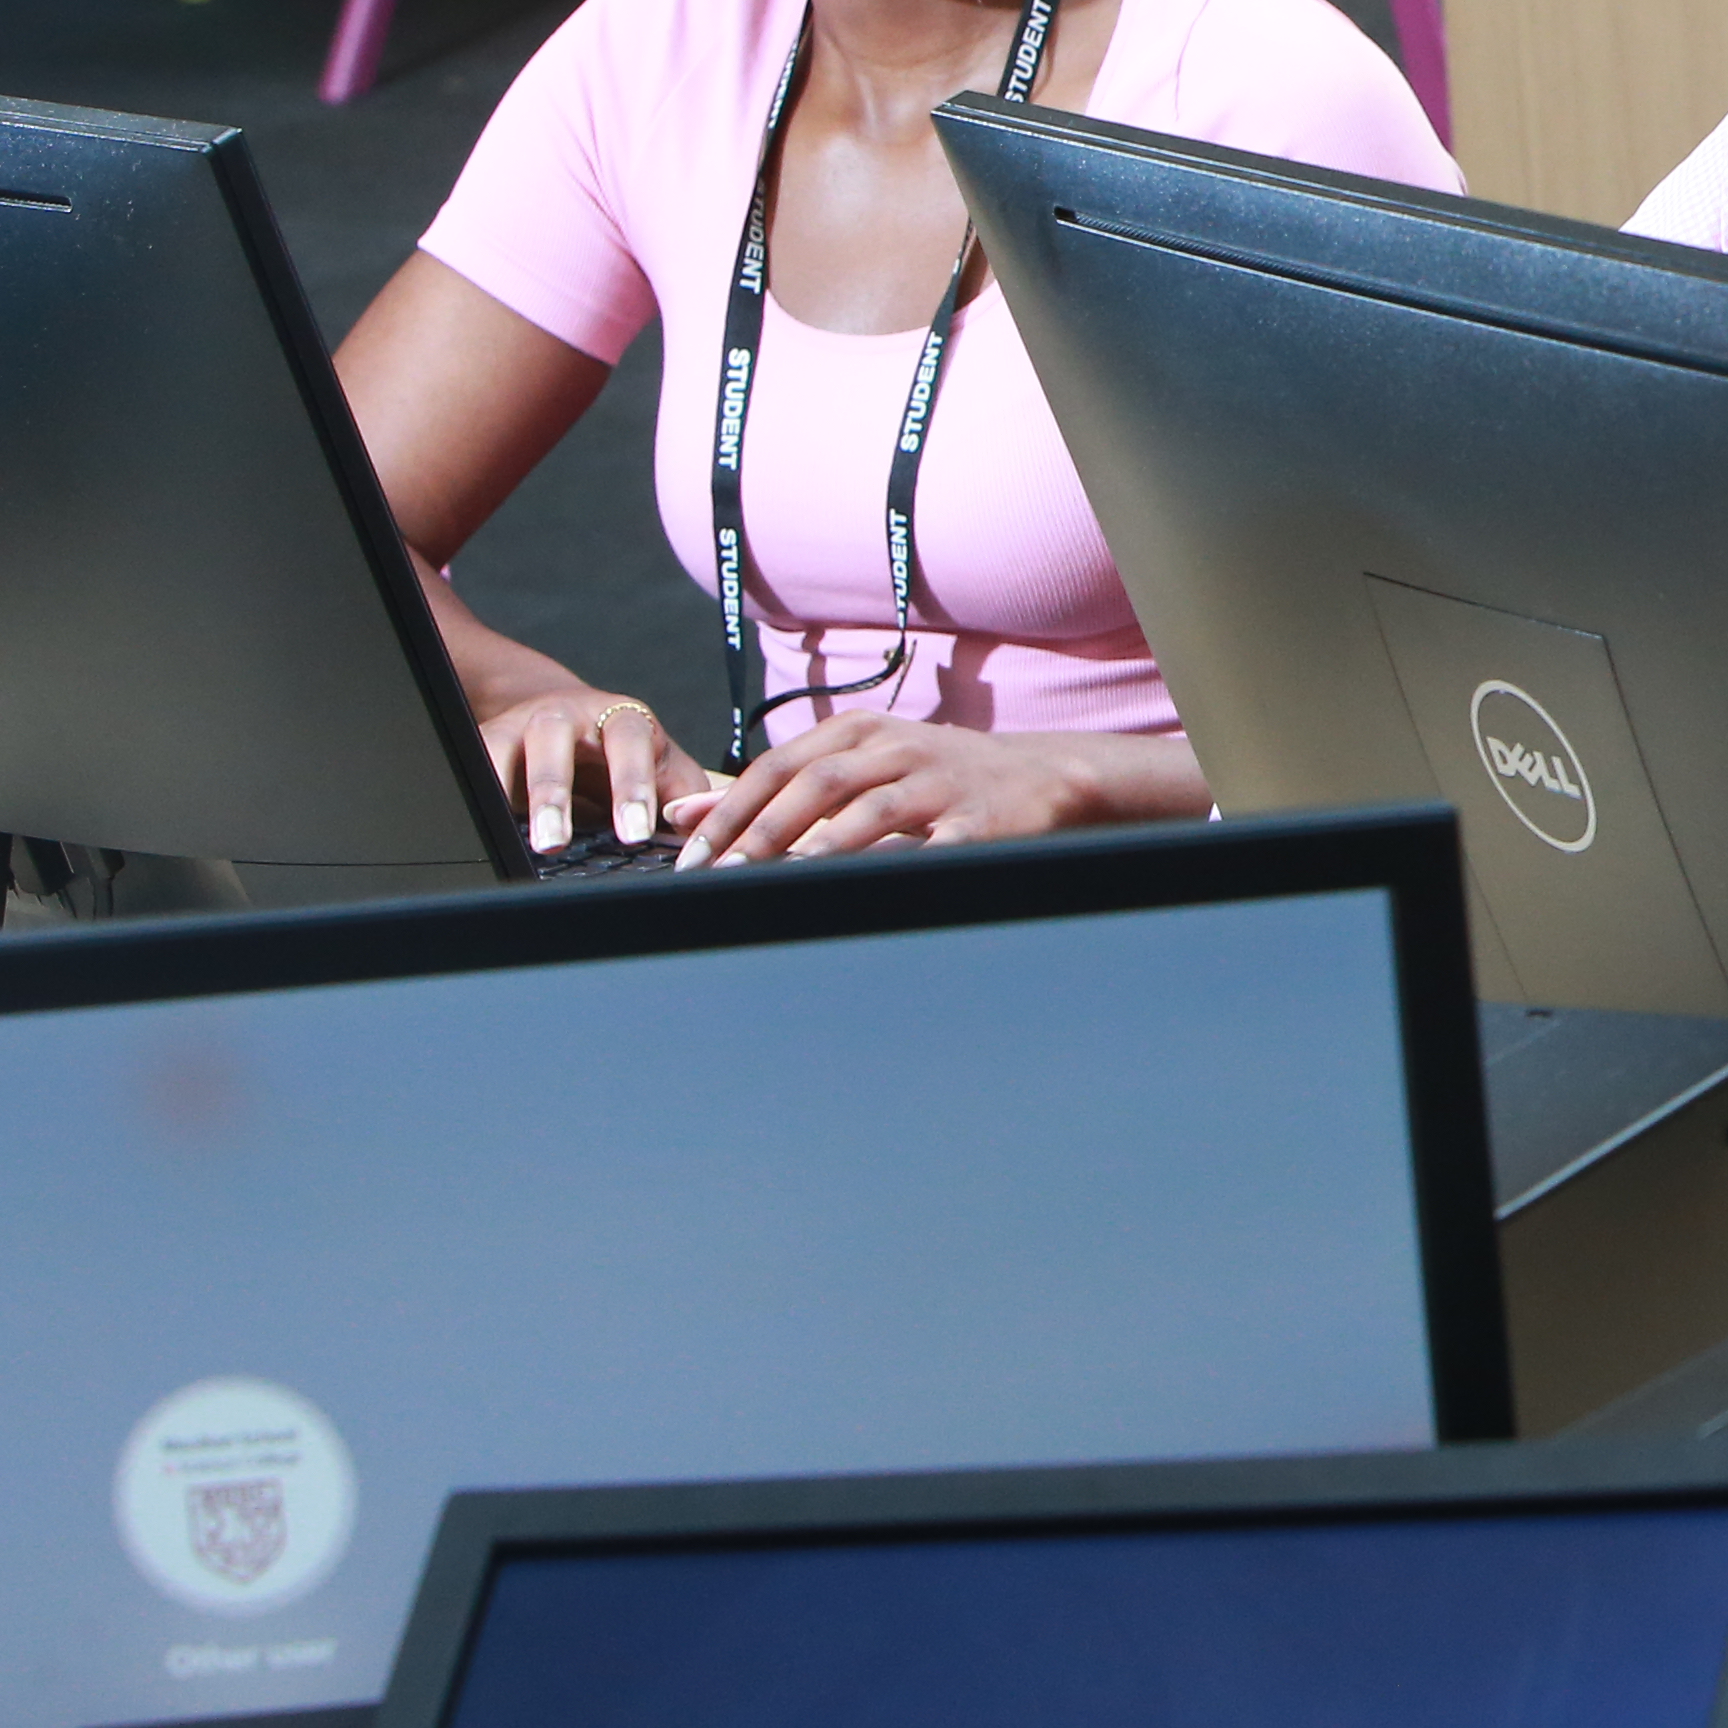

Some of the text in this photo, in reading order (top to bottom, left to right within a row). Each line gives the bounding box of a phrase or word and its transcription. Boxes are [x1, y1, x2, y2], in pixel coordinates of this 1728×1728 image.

[718, 347, 752, 471] STUDENT
[900, 330, 944, 453] STUDENT
[719, 527, 741, 651] STUDENT
[1485, 735, 1583, 799] DELL
